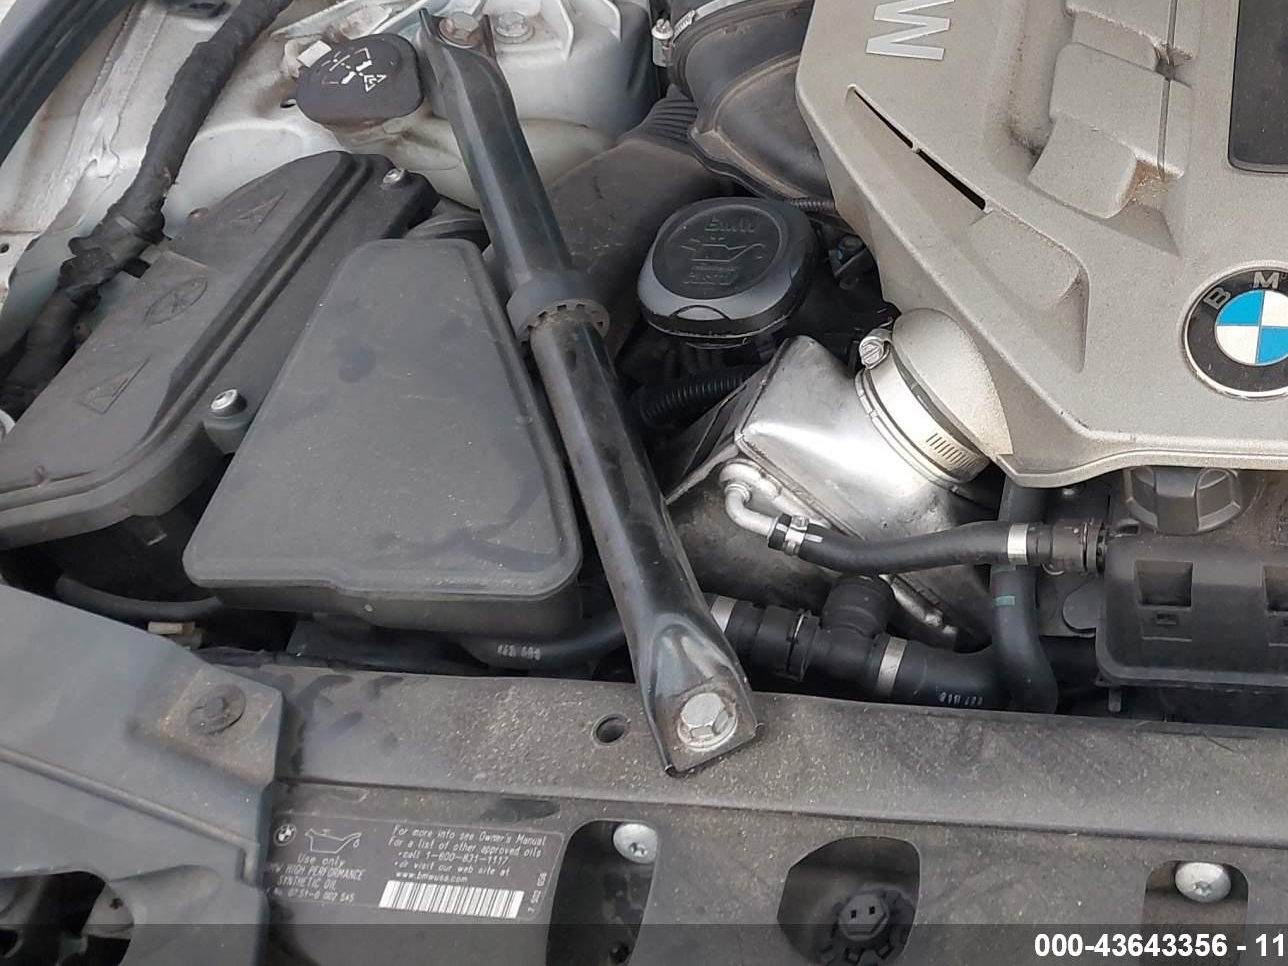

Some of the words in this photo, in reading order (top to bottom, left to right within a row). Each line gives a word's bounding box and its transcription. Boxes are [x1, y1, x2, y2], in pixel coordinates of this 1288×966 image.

[392, 824, 408, 835] For
[438, 828, 455, 839] info
[460, 832, 475, 840] see
[515, 833, 547, 846] Manual
[388, 835, 403, 847] For
[418, 838, 435, 849] list
[438, 840, 450, 850] of
[452, 841, 476, 852] other
[480, 845, 521, 856] approved
[297, 852, 317, 864] Use
[321, 854, 346, 867] only
[414, 861, 435, 870] visit
[308, 865, 366, 881] PERFORMANCE
[323, 878, 337, 891] OIL
